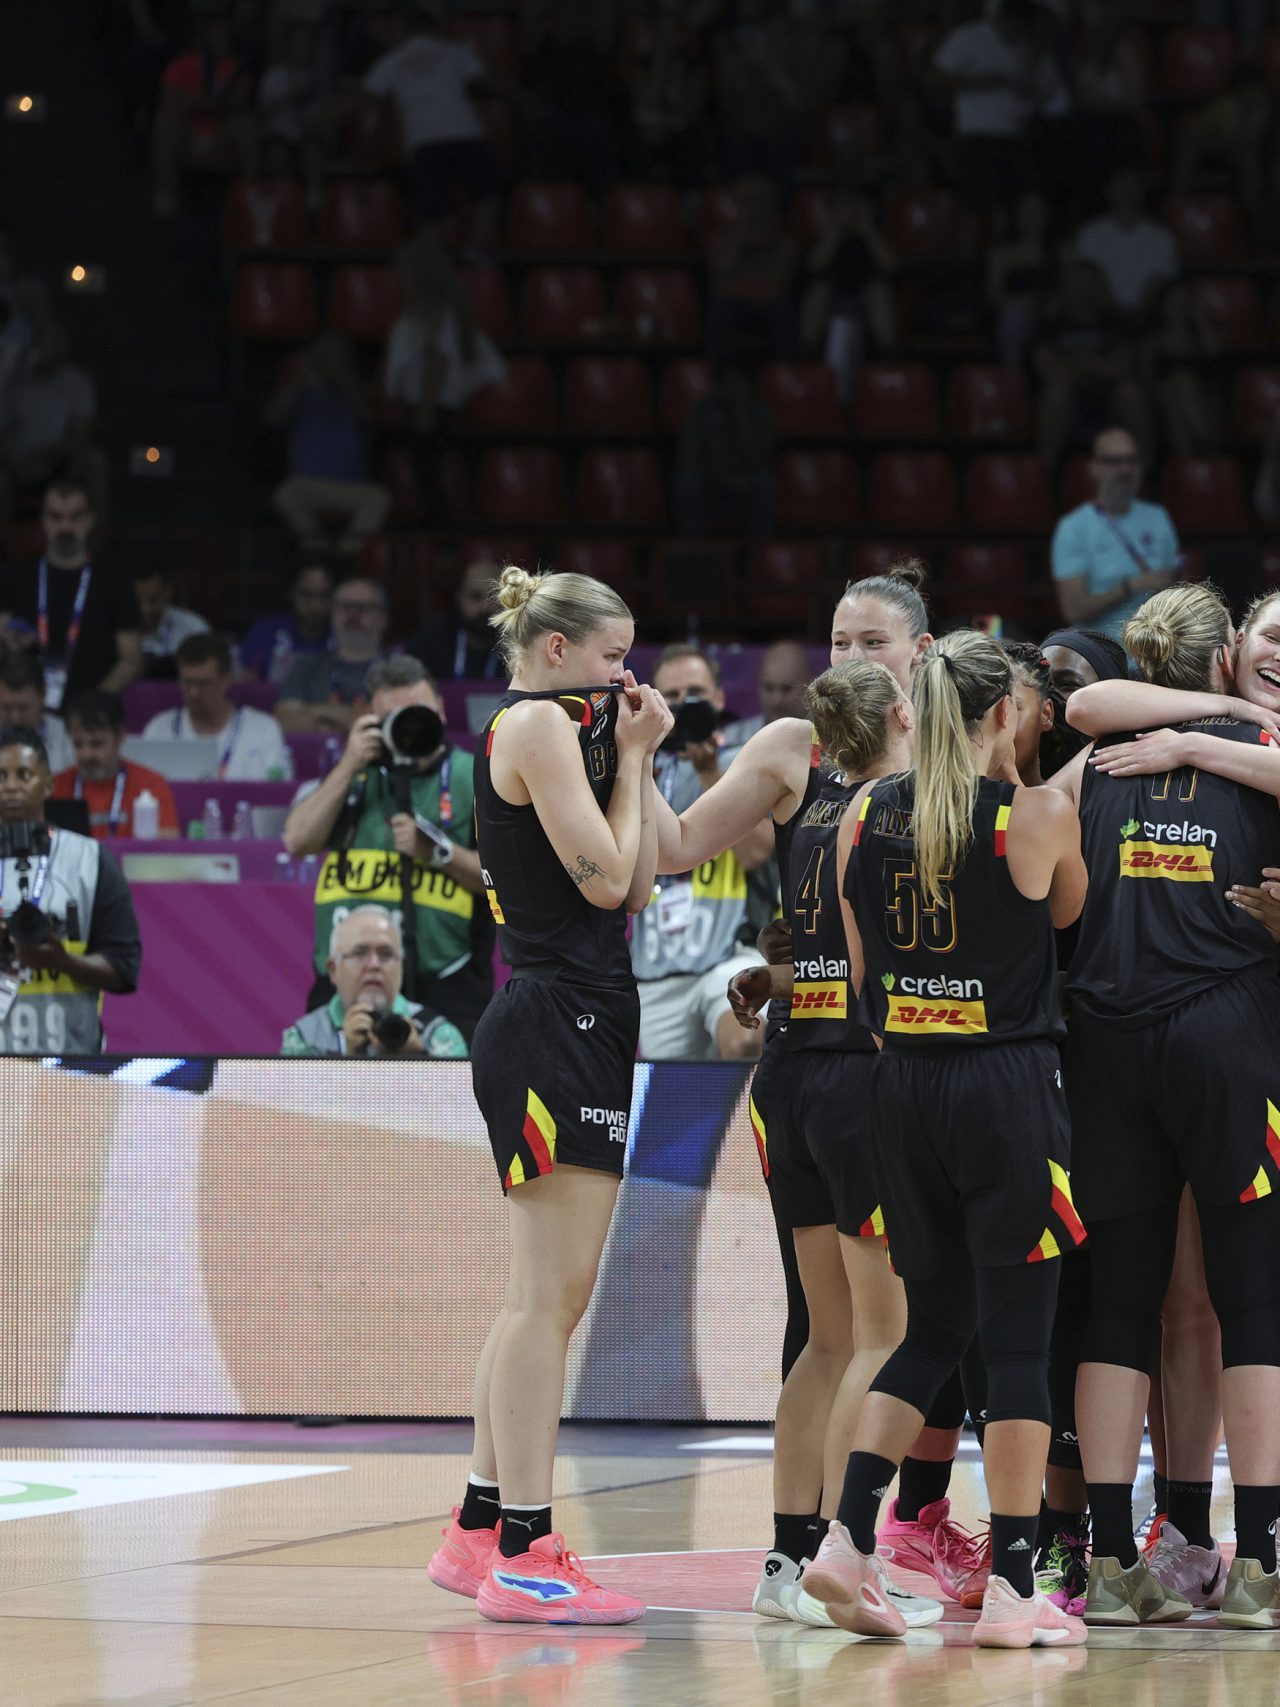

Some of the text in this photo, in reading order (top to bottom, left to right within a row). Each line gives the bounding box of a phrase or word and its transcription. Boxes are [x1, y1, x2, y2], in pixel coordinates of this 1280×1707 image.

[1143, 820, 1218, 848] crelan
[1126, 850, 1206, 873] DHL
[794, 845, 824, 934] 4
[882, 857, 958, 953] 55
[794, 955, 848, 979] crelan
[900, 975, 984, 998] crelan
[791, 991, 843, 1010] DHL
[0, 1001, 65, 1055] 99
[893, 1006, 977, 1026] DHL
